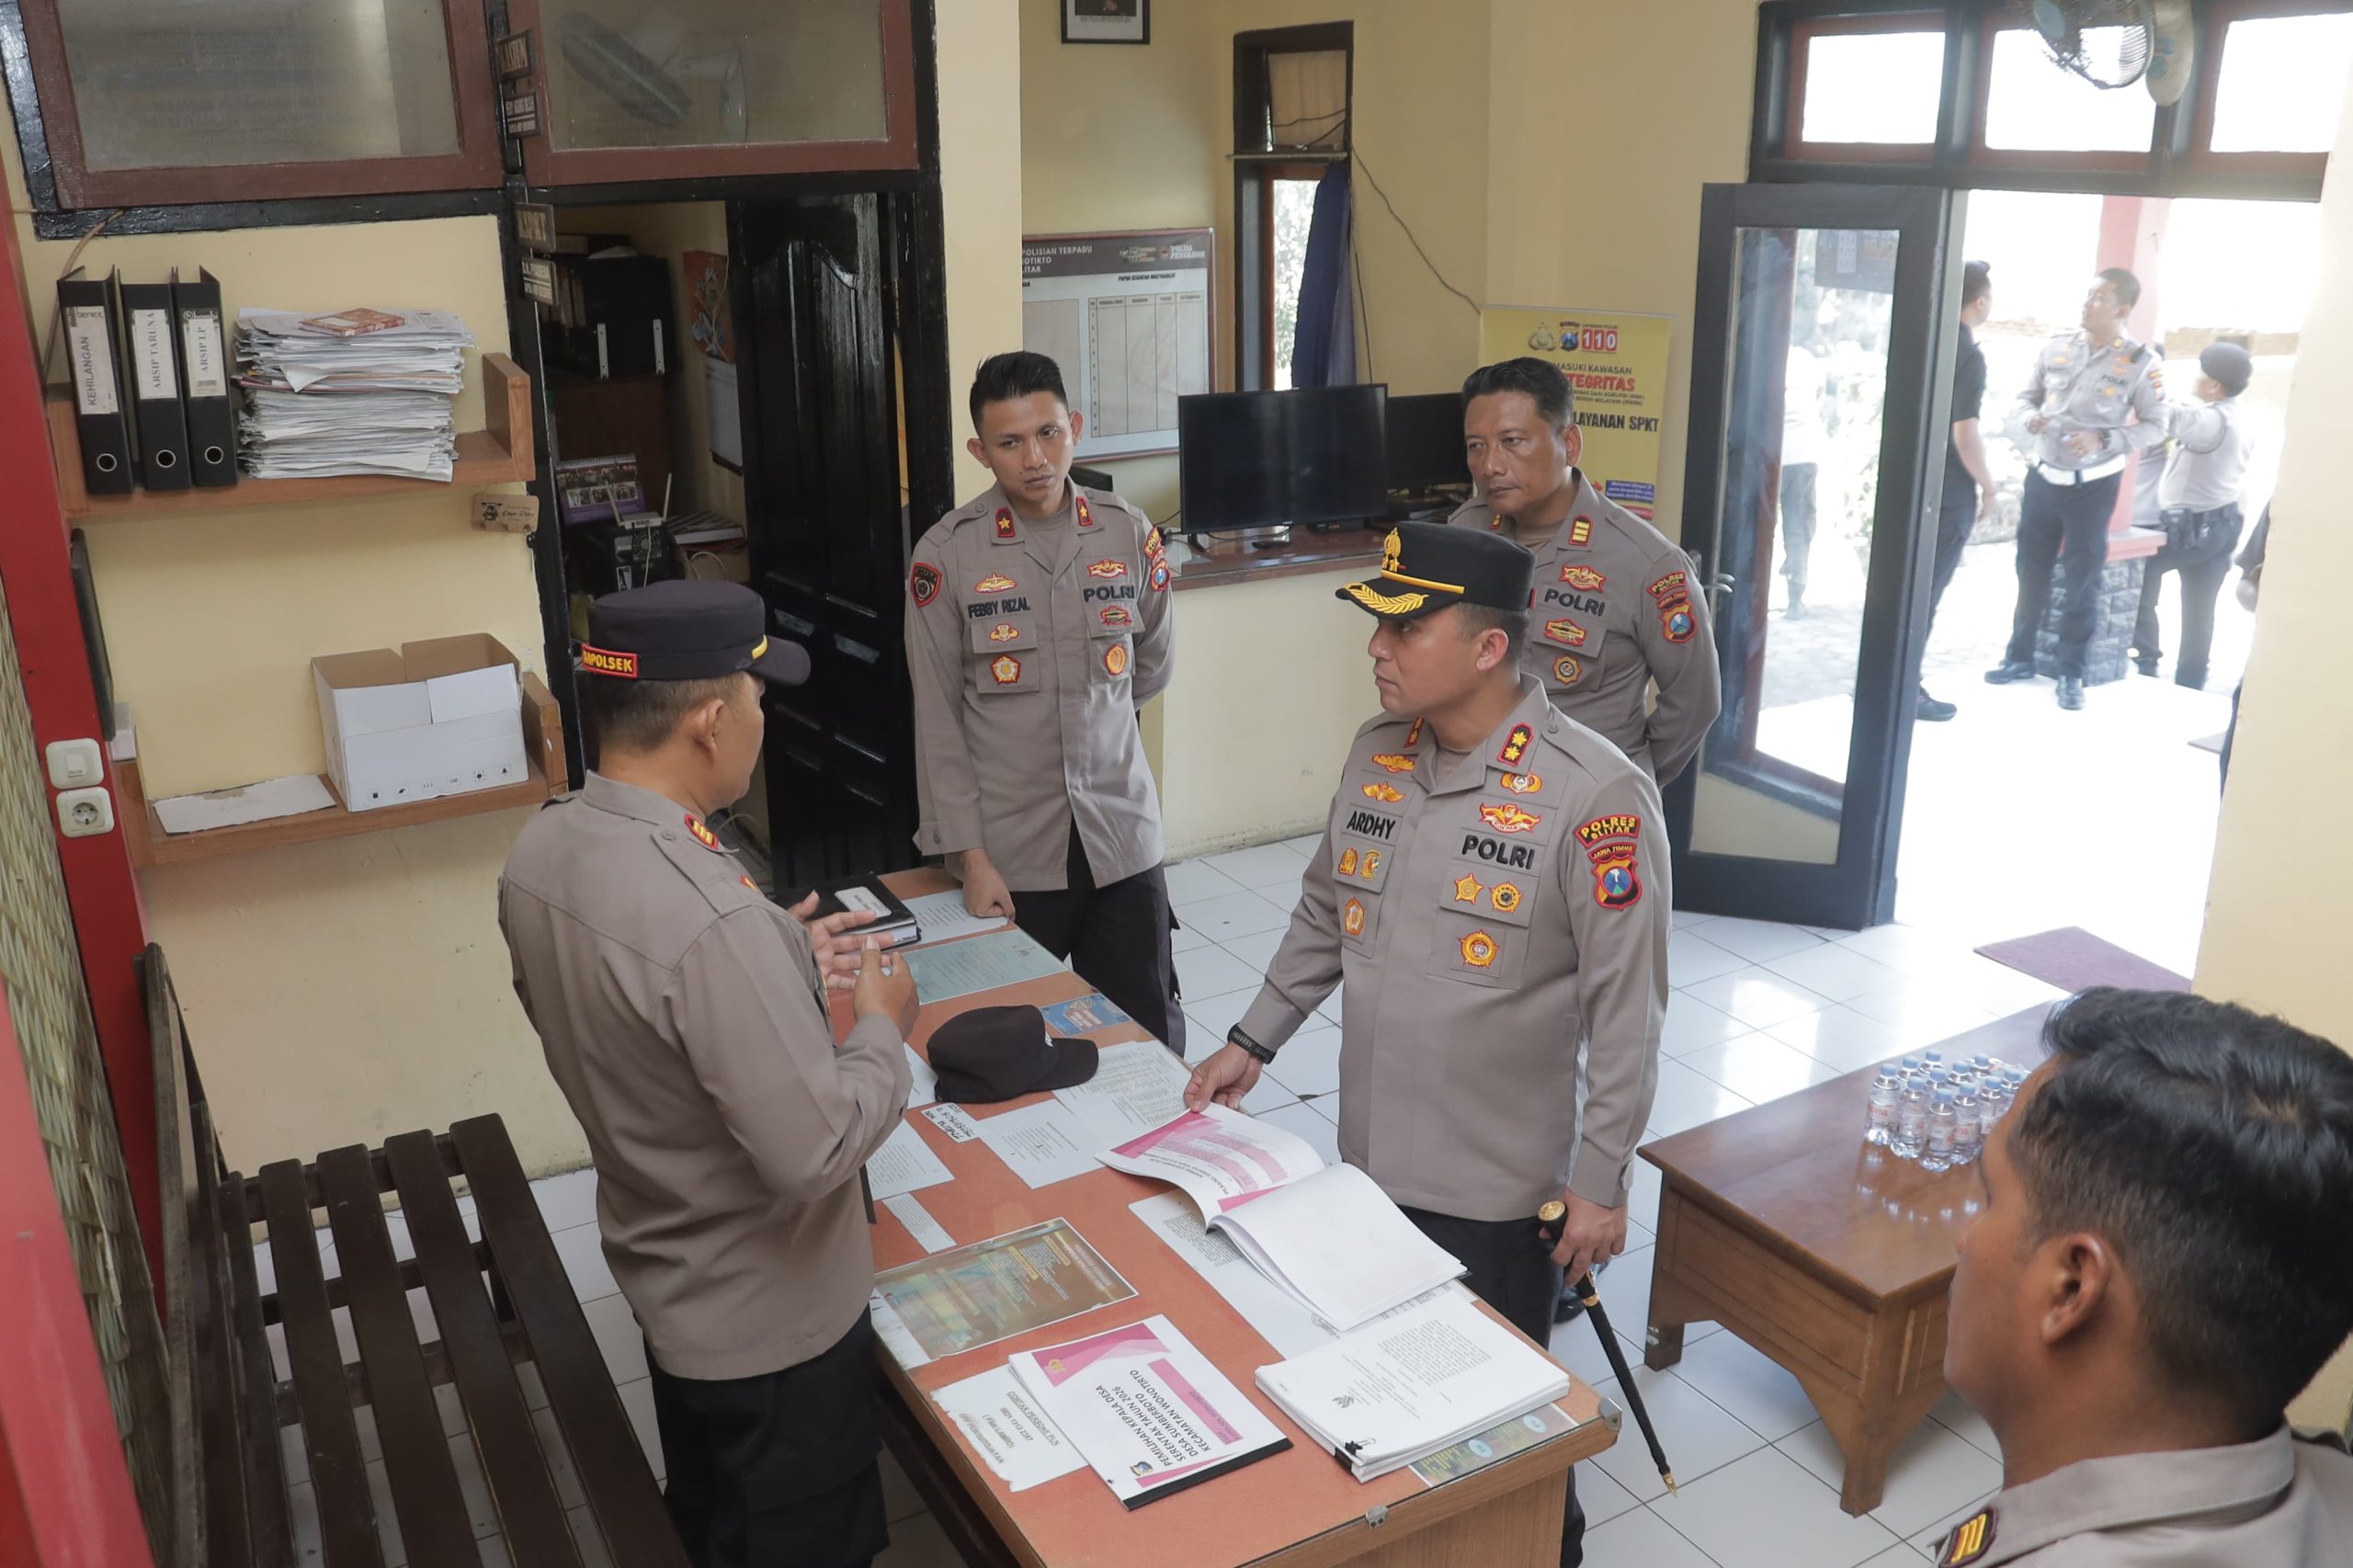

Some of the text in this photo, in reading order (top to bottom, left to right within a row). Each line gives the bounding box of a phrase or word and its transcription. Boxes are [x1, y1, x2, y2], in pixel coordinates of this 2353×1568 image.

[1022, 256, 1051, 265] OTIRTO
[1059, 245, 1092, 255] TERPADU
[147, 312, 162, 389] ARSIP TARUNA
[198, 326, 209, 372] ARSIP LP
[1583, 331, 1617, 349] 110
[80, 336, 97, 406] KEHILANGAN
[1588, 365, 1632, 375] KAWASAN
[1566, 372, 1635, 392] TEGRITAS
[1629, 415, 1659, 432] SPKT
[1083, 585, 1135, 602] POLRI
[1544, 588, 1606, 617] POLRI
[1002, 597, 1030, 613] RIZAL
[1347, 810, 1396, 839] ARDHY
[1581, 816, 1635, 838] POLRES
[1590, 826, 1630, 840] BLITAR
[1461, 835, 1535, 869] POLRI
[1593, 848, 1610, 858] JAWA
[1129, 1369, 1211, 1452] KECAMATAN WONOTIRTO
[1096, 1384, 1173, 1467] PEMILIHAN KEPALA DESA
[1112, 1385, 1187, 1462] SERENTAK TAHUN 2026
[1134, 1392, 1199, 1457] DESA SUMBERBOTO
[1048, 1434, 1060, 1447] PLN
